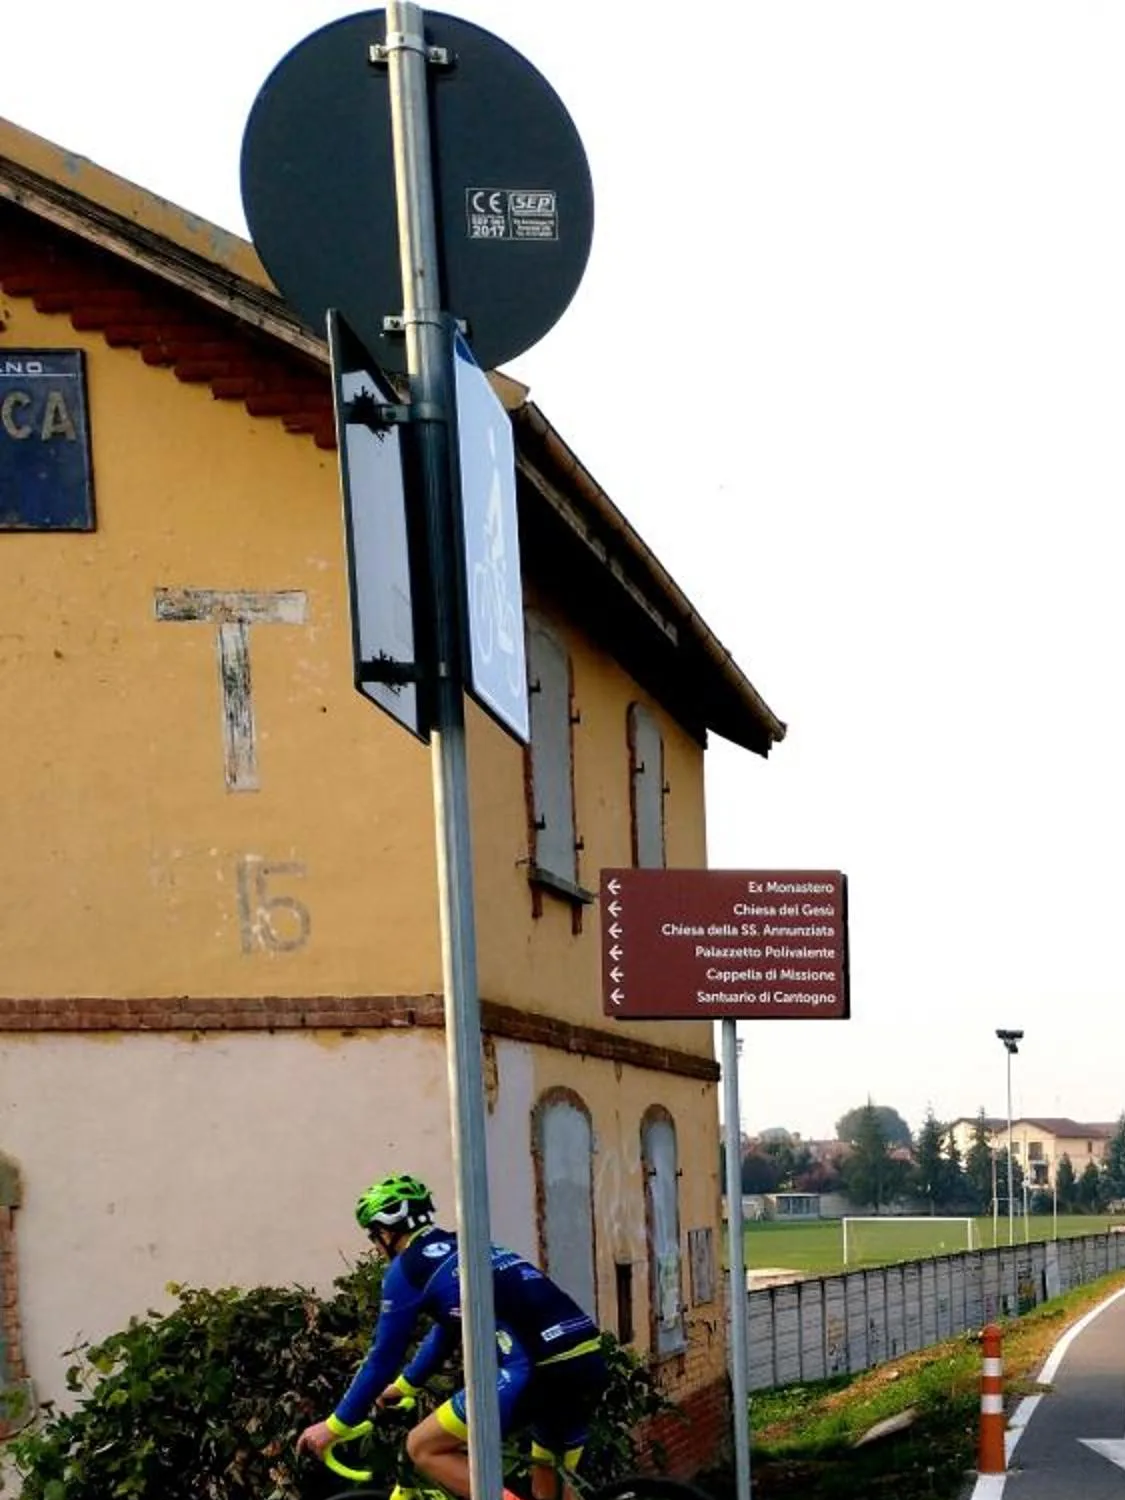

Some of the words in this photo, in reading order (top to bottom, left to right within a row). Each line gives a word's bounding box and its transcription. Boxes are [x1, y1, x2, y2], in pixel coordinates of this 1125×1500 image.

[472, 191, 502, 213] CE
[471, 225, 505, 238] 2017
[0, 361, 43, 374] NO
[748, 880, 764, 894] Ex
[766, 880, 835, 894] Monastero
[733, 903, 777, 917] Chiesa
[801, 903, 835, 917] Gesù
[661, 923, 705, 937] Chiesa
[707, 923, 739, 937] della
[741, 923, 760, 937] SS.
[763, 923, 835, 937] Annunziata
[695, 945, 762, 959] Palazzetto
[765, 945, 836, 959] Polivalente
[706, 967, 763, 983] Cappella
[765, 968, 777, 981] di
[780, 968, 836, 981] Missione
[697, 990, 757, 1004] Santuario
[759, 990, 771, 1004] di
[773, 991, 837, 1007] Cantogno
